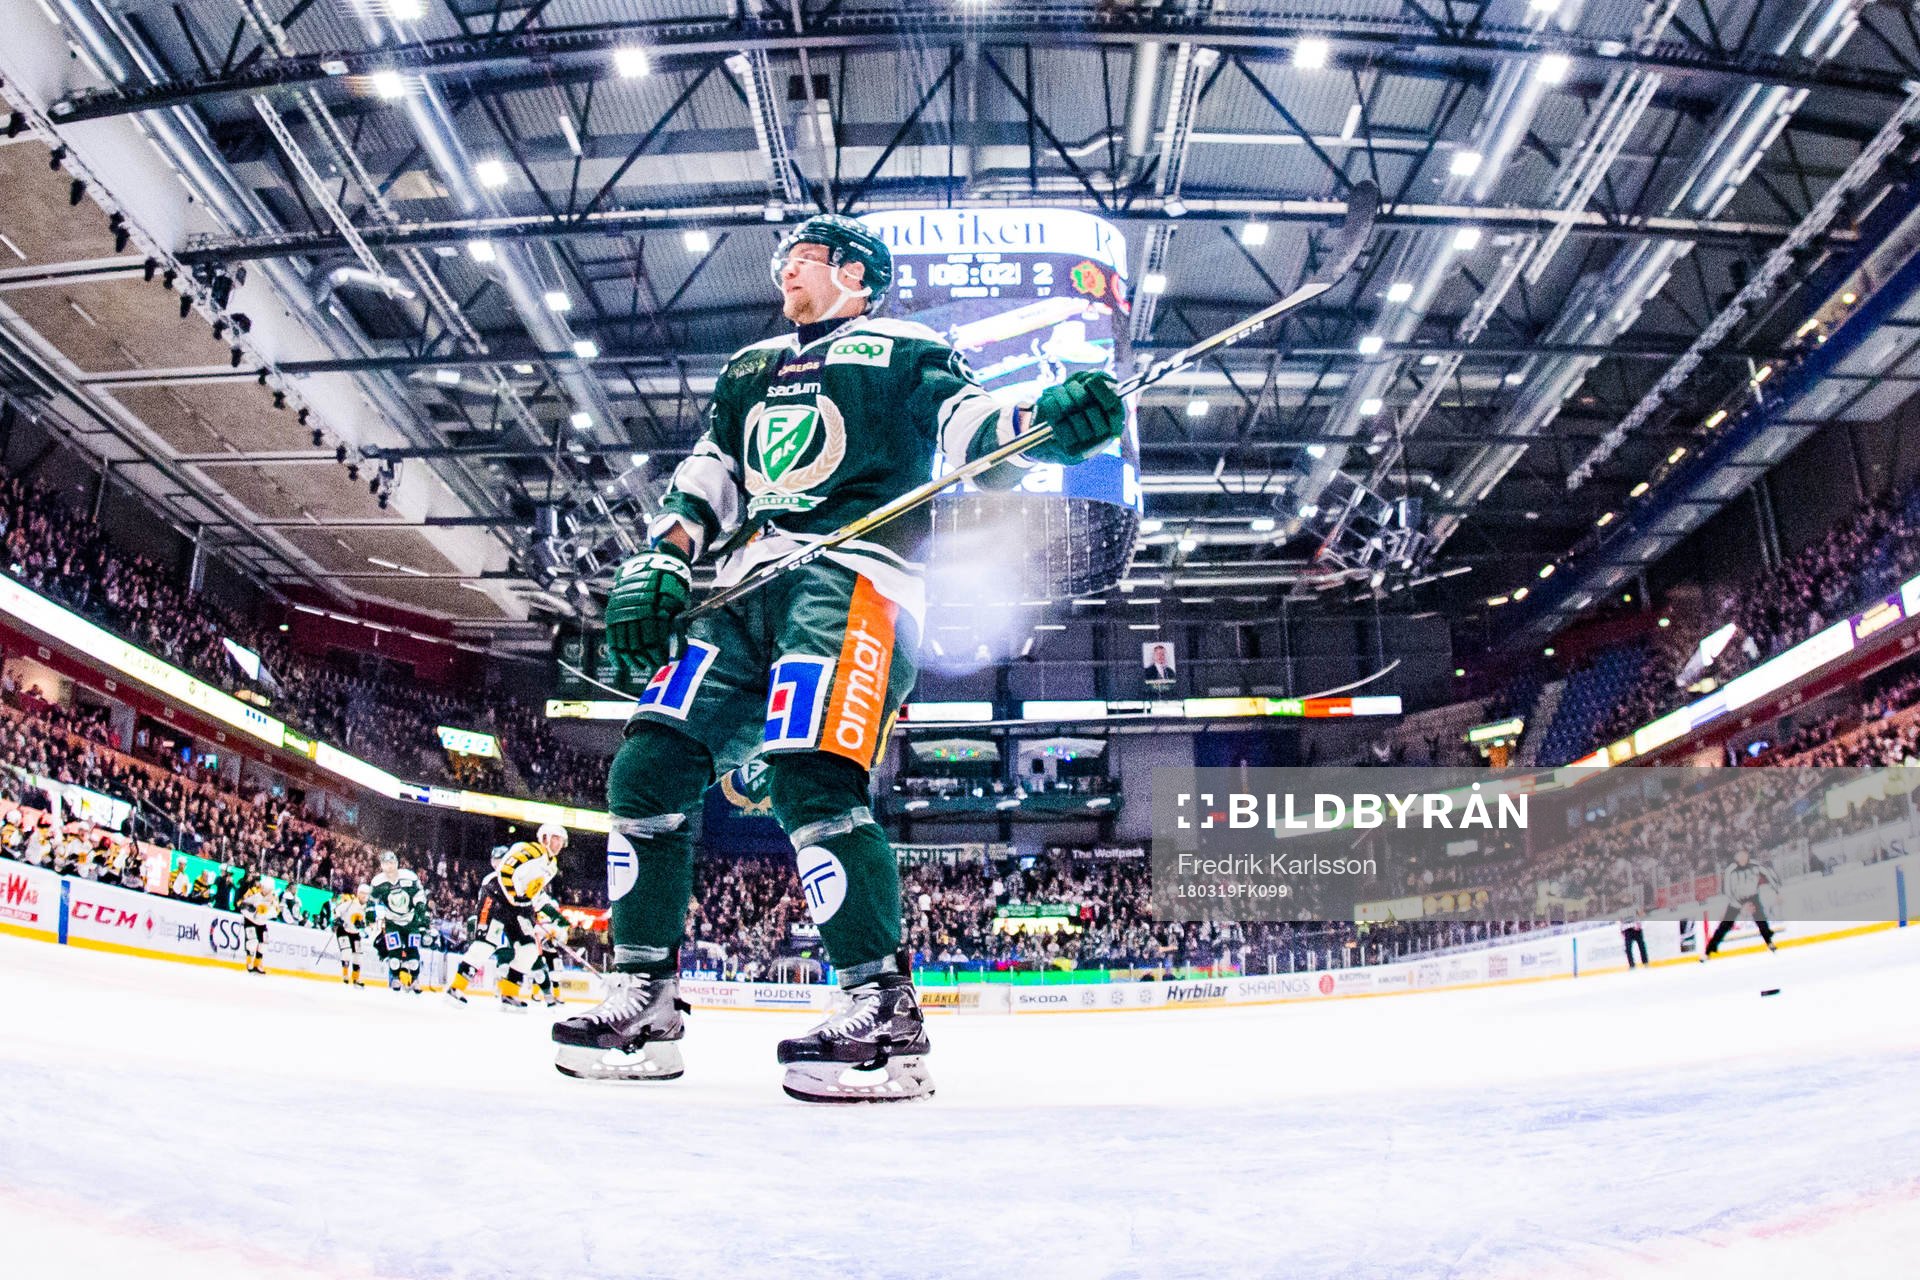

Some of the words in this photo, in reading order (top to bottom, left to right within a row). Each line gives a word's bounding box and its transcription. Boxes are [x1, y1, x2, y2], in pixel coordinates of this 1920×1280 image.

[1032, 262, 1054, 286] 2
[833, 342, 884, 359] coop
[1094, 848, 1145, 859] Wolfpack
[71, 901, 138, 929] CCM
[1167, 983, 1228, 1001] Hyrbilar
